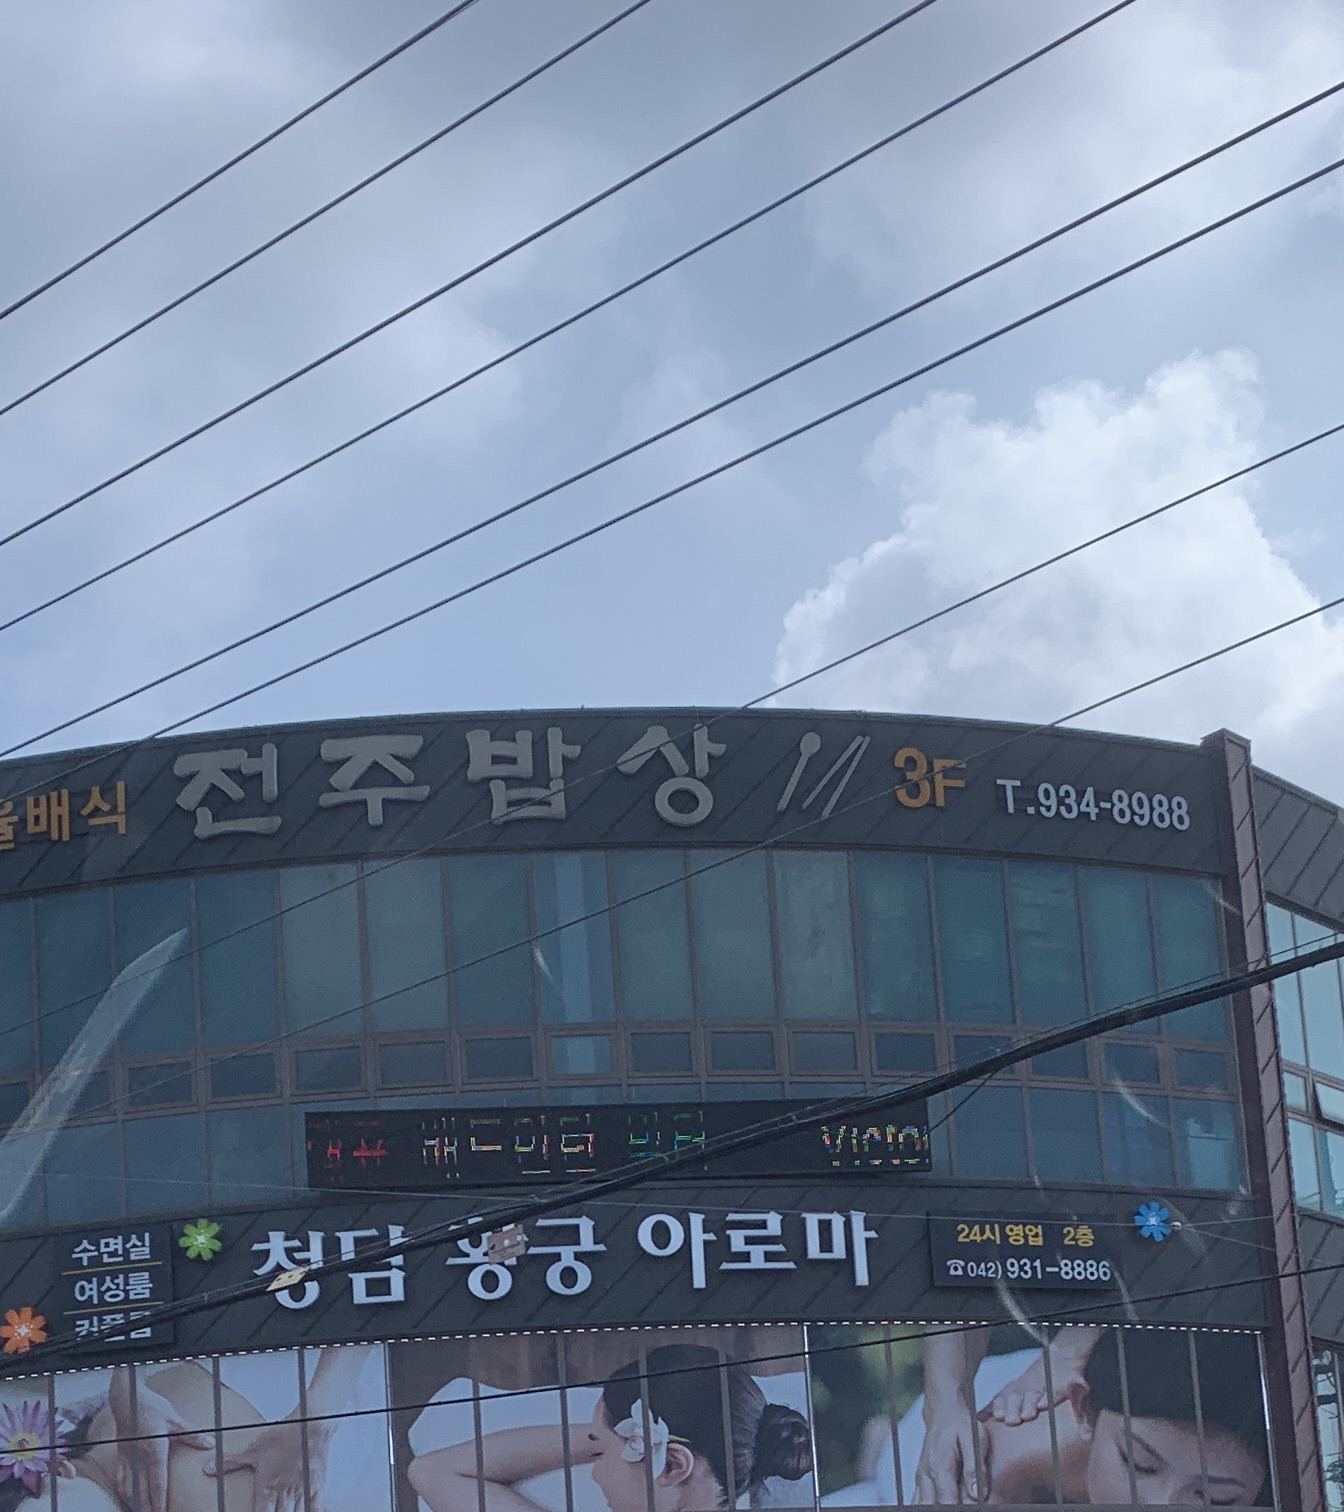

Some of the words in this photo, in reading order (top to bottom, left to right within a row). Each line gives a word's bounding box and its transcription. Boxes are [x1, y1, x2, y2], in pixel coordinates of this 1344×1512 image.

[173, 723, 727, 841] 전주밥상
[894, 747, 966, 808] 3F
[996, 778, 1190, 830] T.934-8988
[72, 1232, 151, 1266] 수면실
[957, 1224, 1001, 1245] 24시
[1005, 1224, 1043, 1246] 영업
[1063, 1225, 1094, 1247] 2층
[251, 1225, 412, 1309] 청담
[638, 1210, 878, 1289] 아로마
[1006, 1257, 1110, 1281] 931-8886
[74, 1272, 153, 1304] 여성룸
